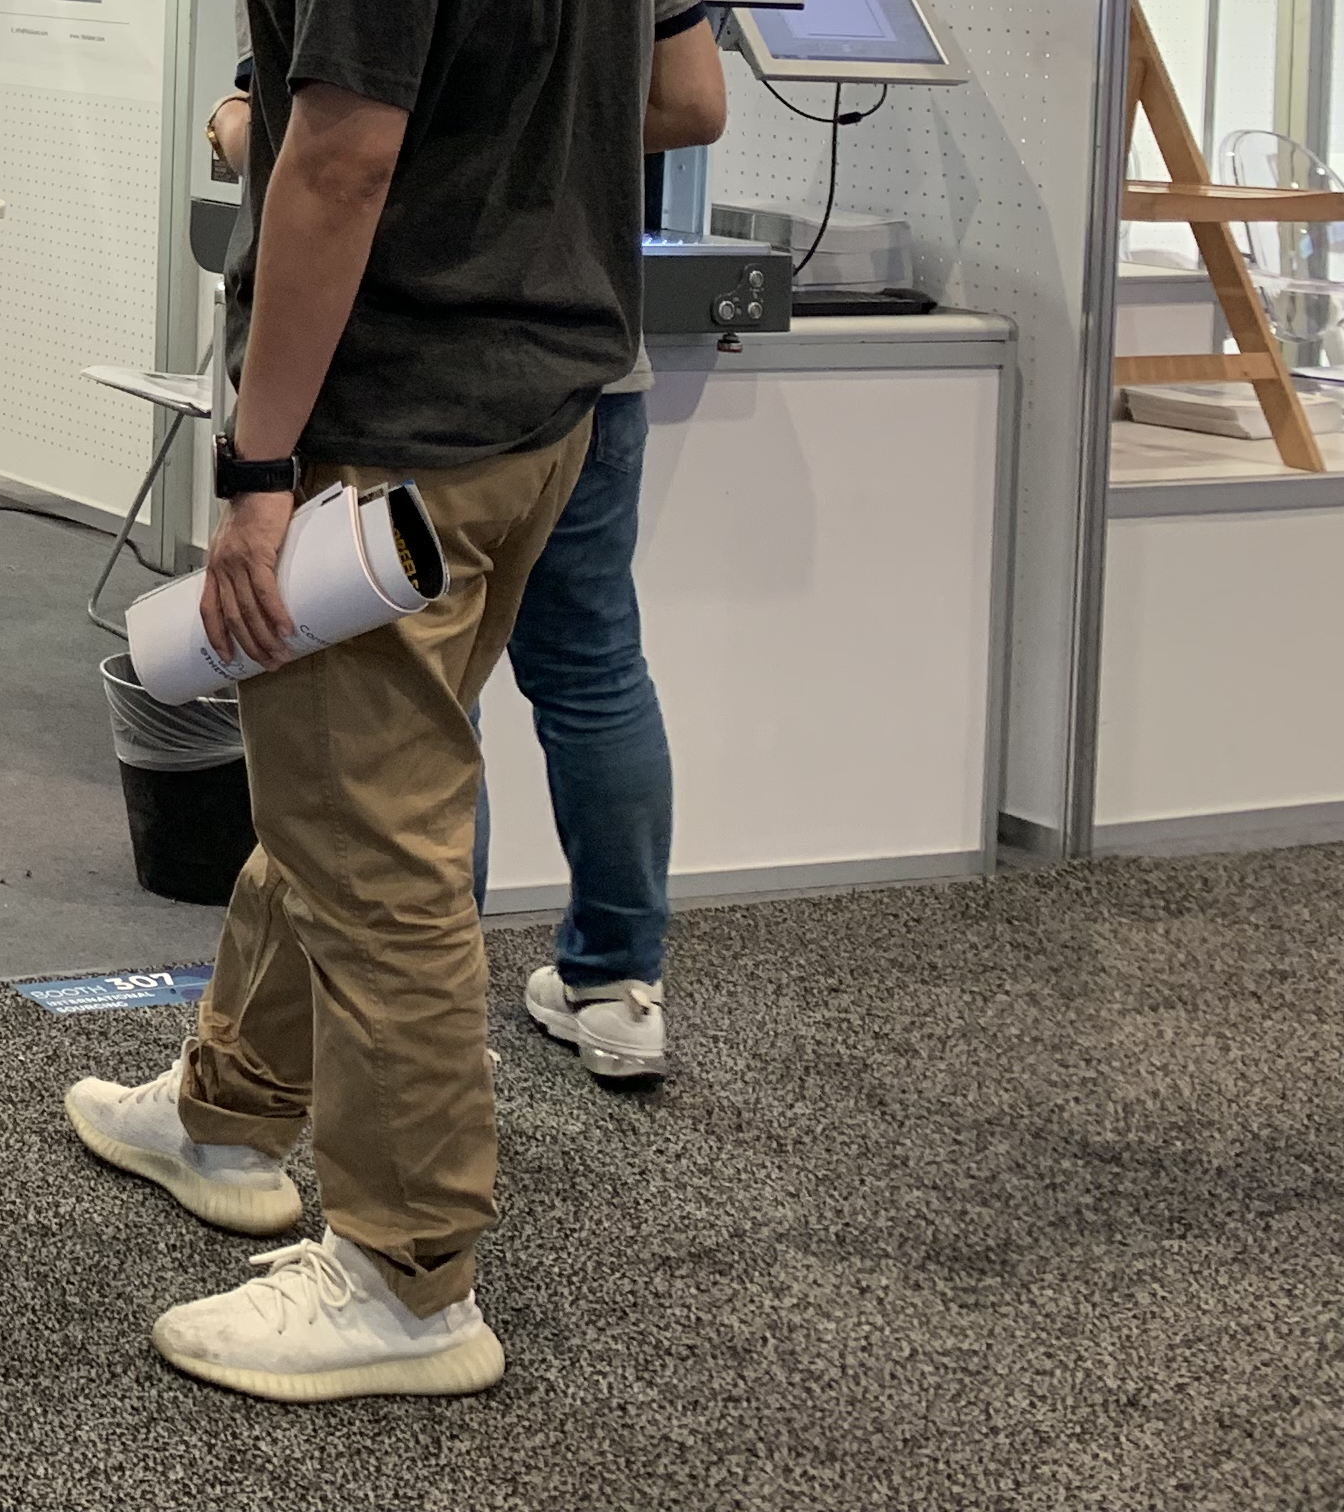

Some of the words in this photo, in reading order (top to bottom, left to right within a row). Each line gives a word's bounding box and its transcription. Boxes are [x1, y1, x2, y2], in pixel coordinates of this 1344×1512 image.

[30, 984, 108, 1001] BOOTH
[104, 972, 176, 991] 307
[46, 991, 156, 1007] INTERNATIONAL
[56, 1000, 129, 1013] SOURCING
